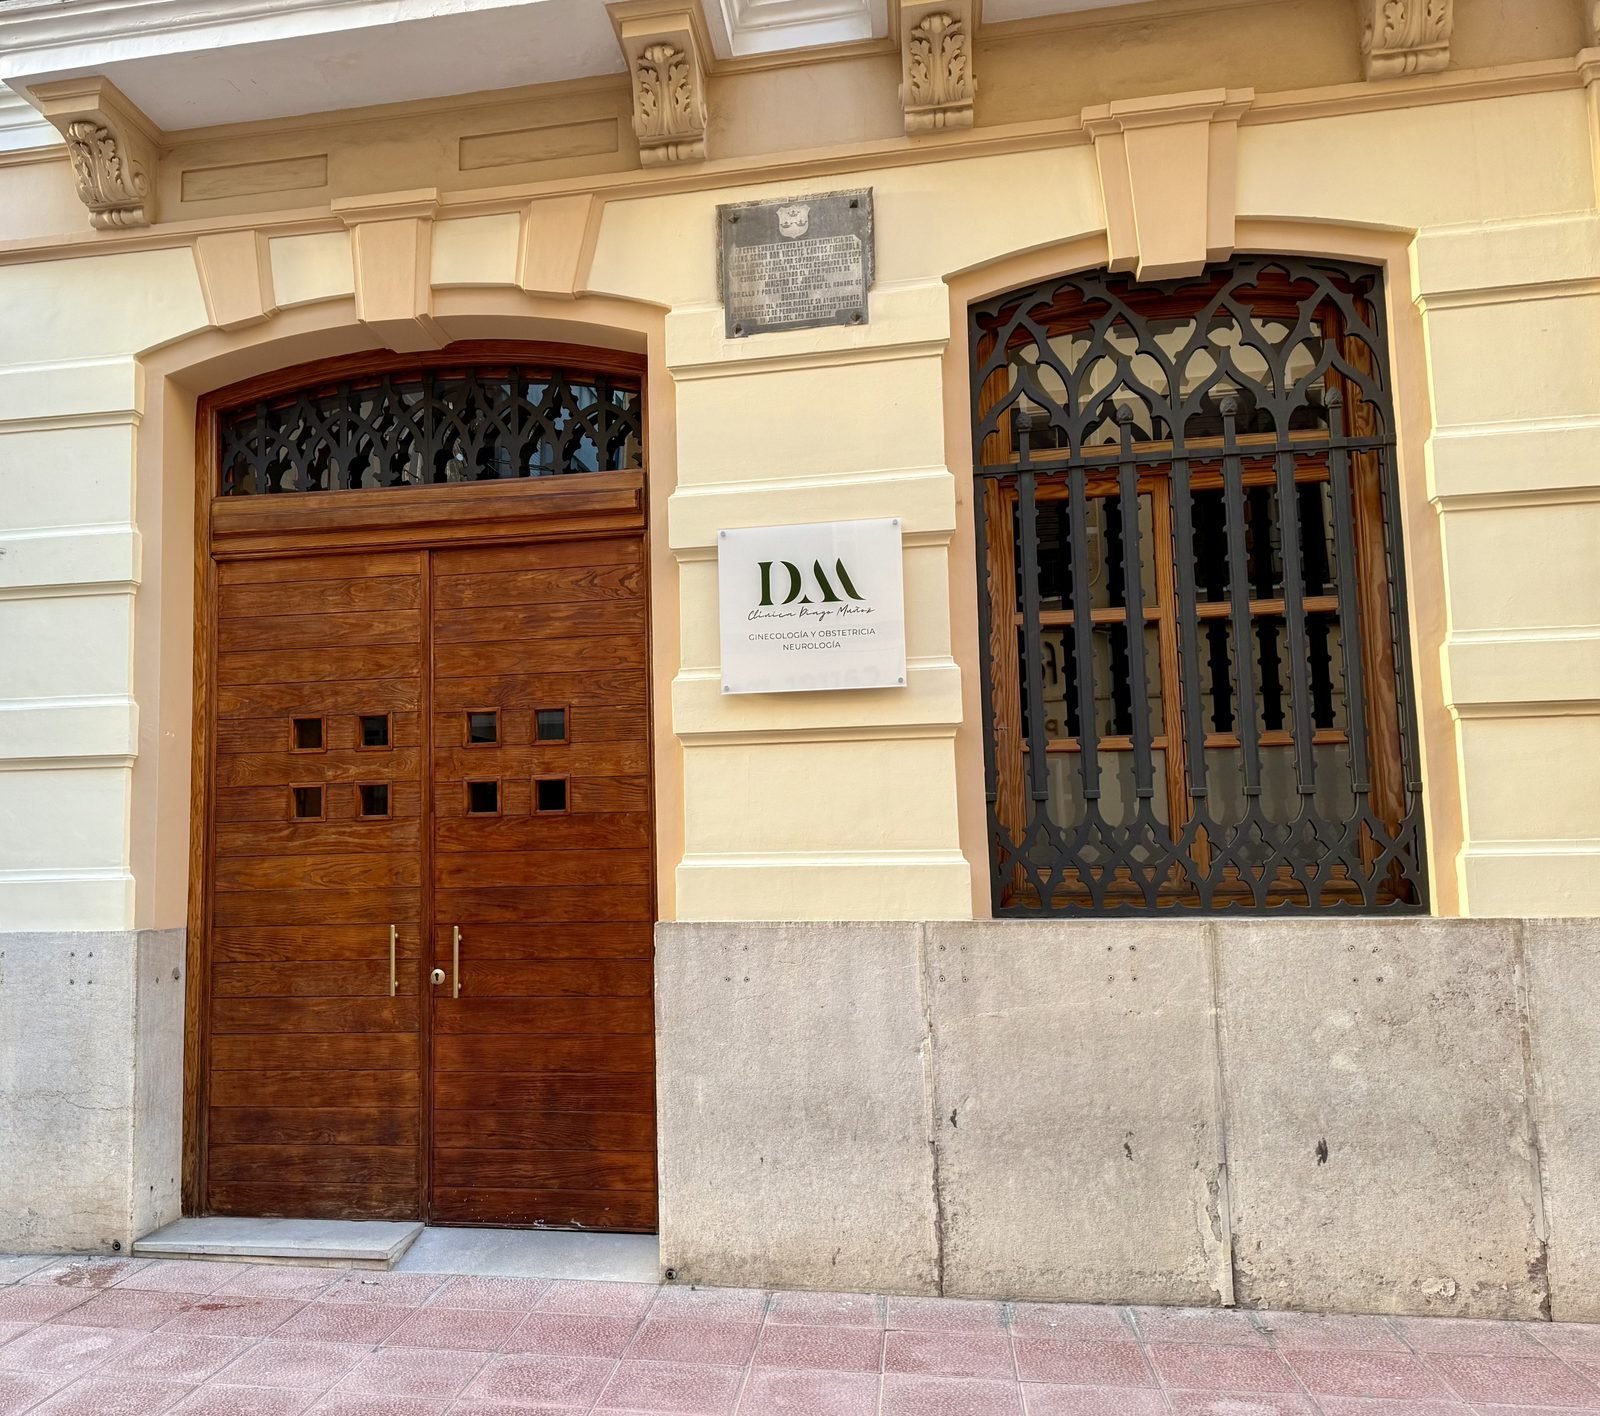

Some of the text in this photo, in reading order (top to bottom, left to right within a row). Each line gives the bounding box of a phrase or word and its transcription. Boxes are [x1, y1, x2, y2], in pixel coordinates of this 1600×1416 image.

[757, 557, 866, 606] DM
[836, 604, 875, 616] Muñoz
[749, 631, 808, 640] GINECOLOGÍA
[819, 628, 875, 637] OBSTETRICIA
[783, 642, 841, 651] NEUROLOGÍA
